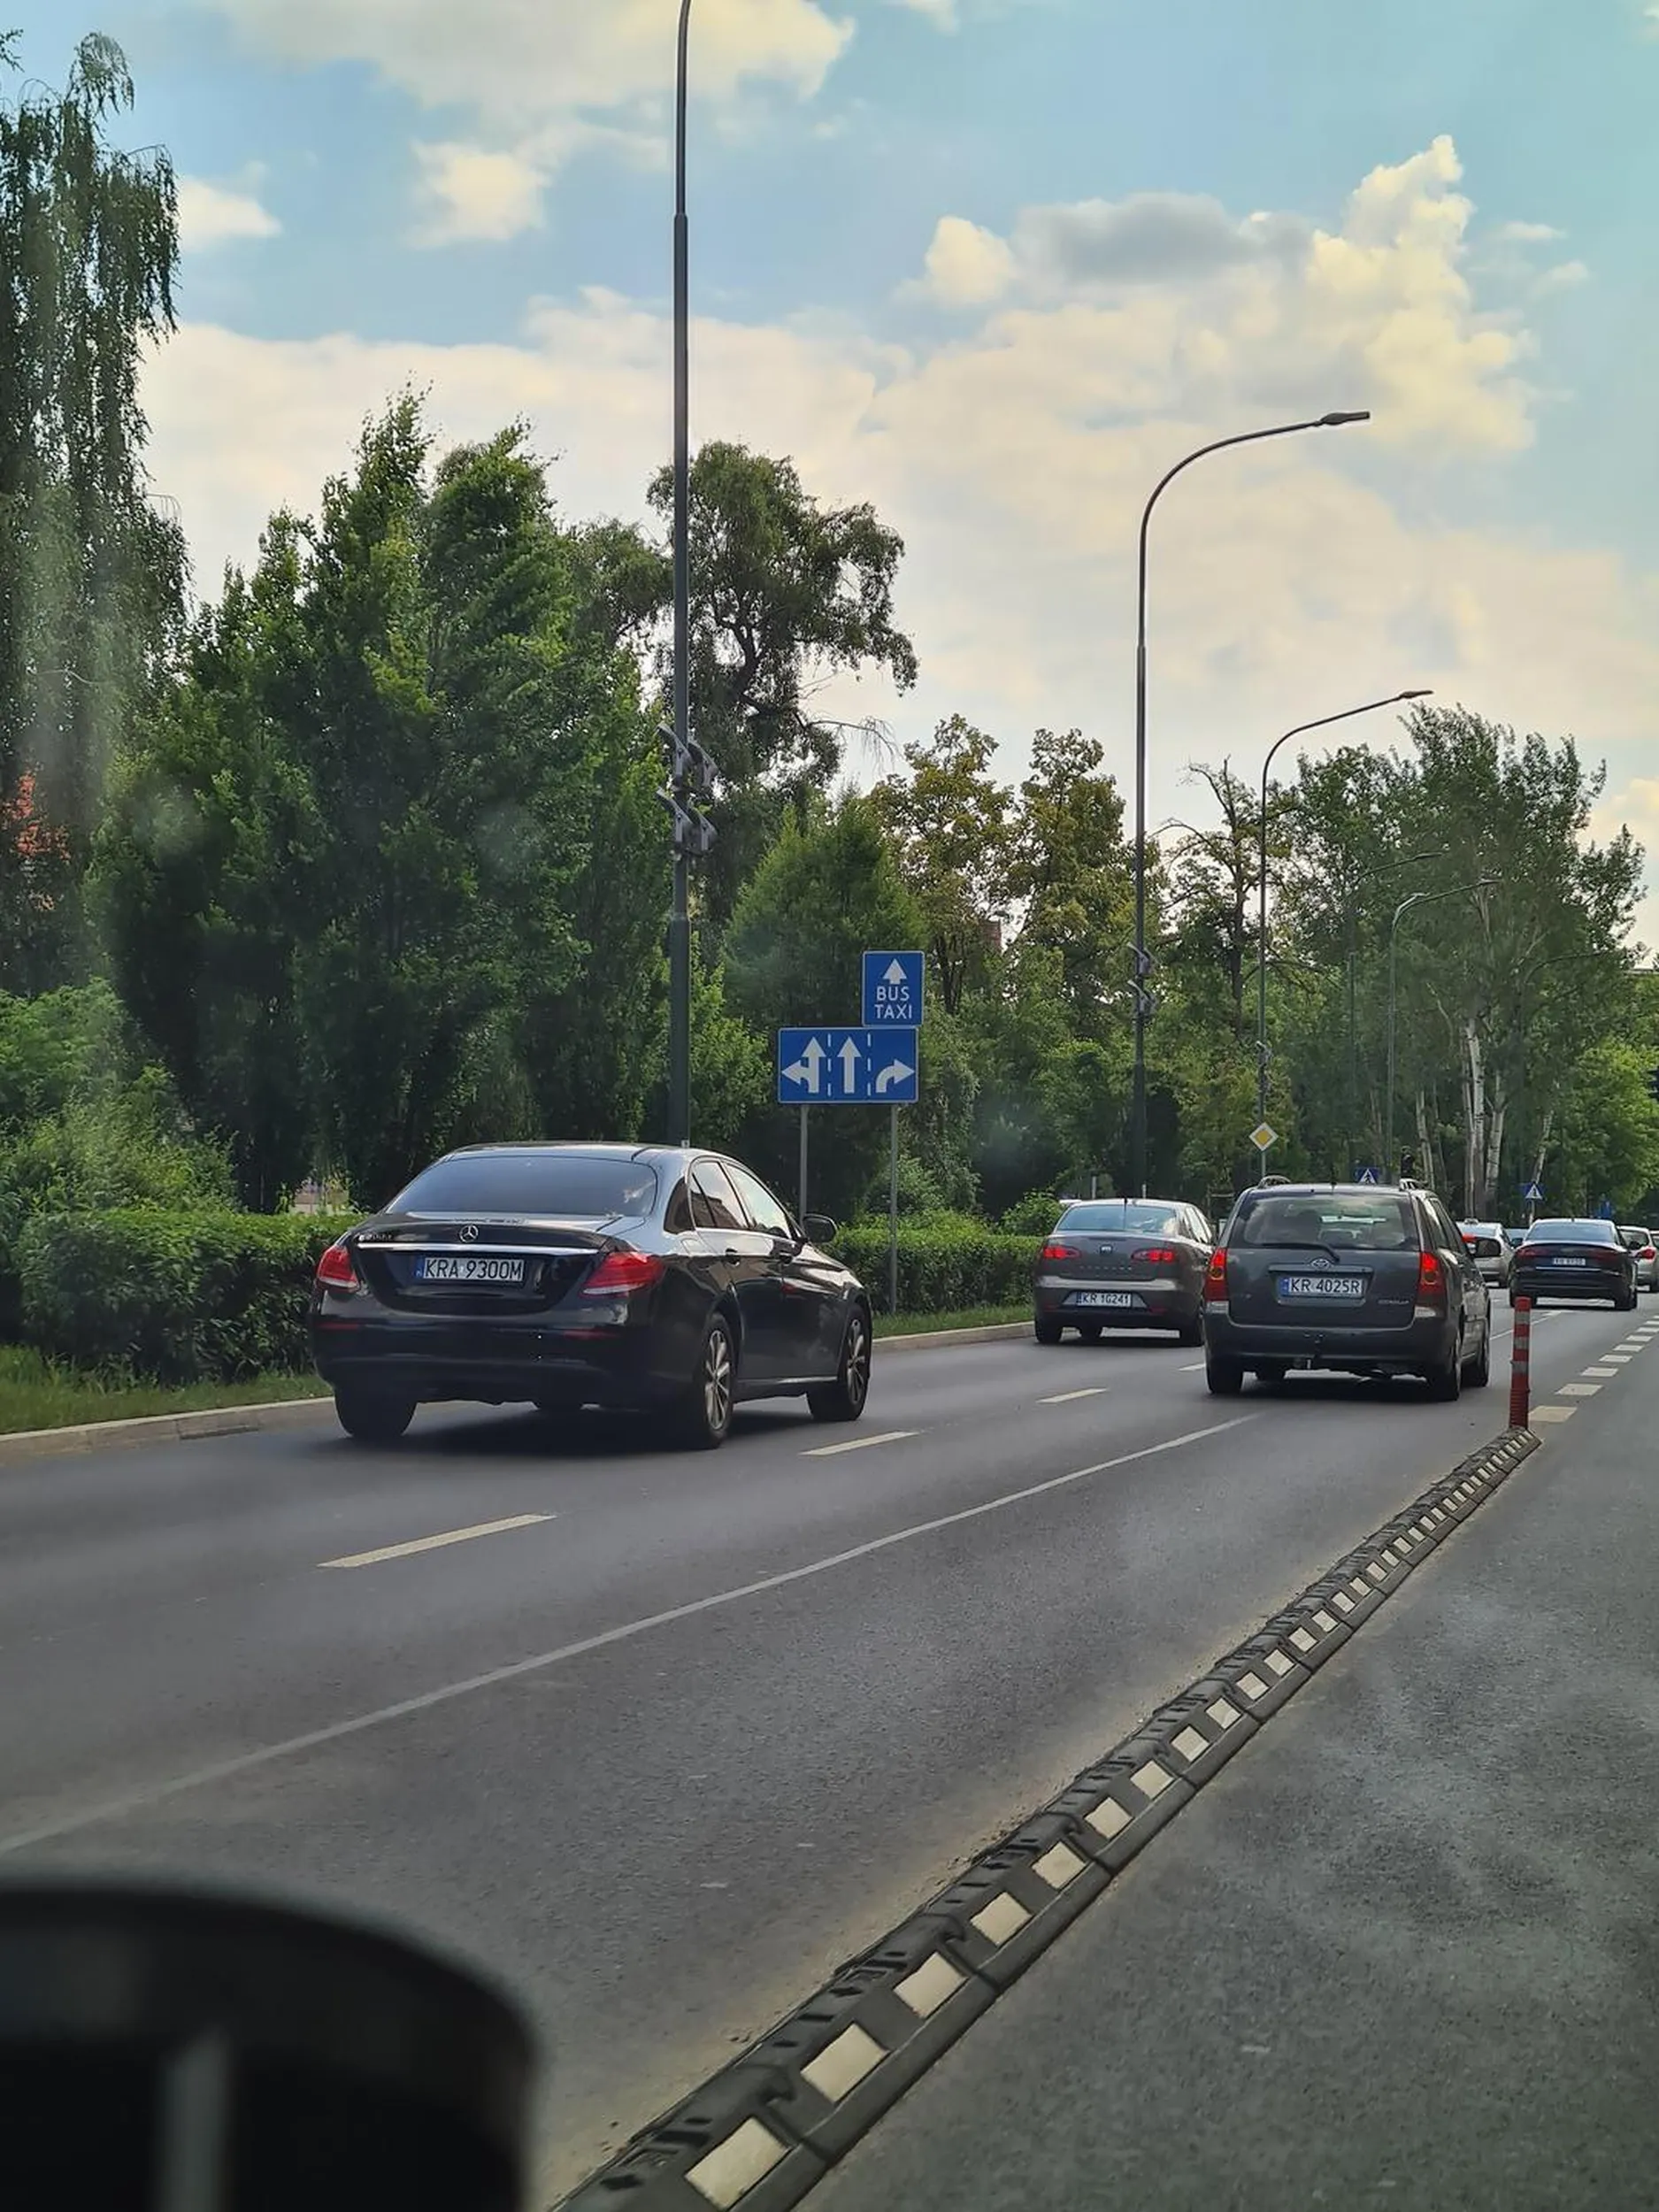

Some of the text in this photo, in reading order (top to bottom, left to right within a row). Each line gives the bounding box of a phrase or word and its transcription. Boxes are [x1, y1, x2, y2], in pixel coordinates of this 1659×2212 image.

[877, 986, 910, 1001] BUS
[874, 1004, 912, 1019] TAXI
[426, 1259, 522, 1279] KRA 9300M
[1291, 1279, 1310, 1291] KR
[1082, 1293, 1097, 1303] KR
